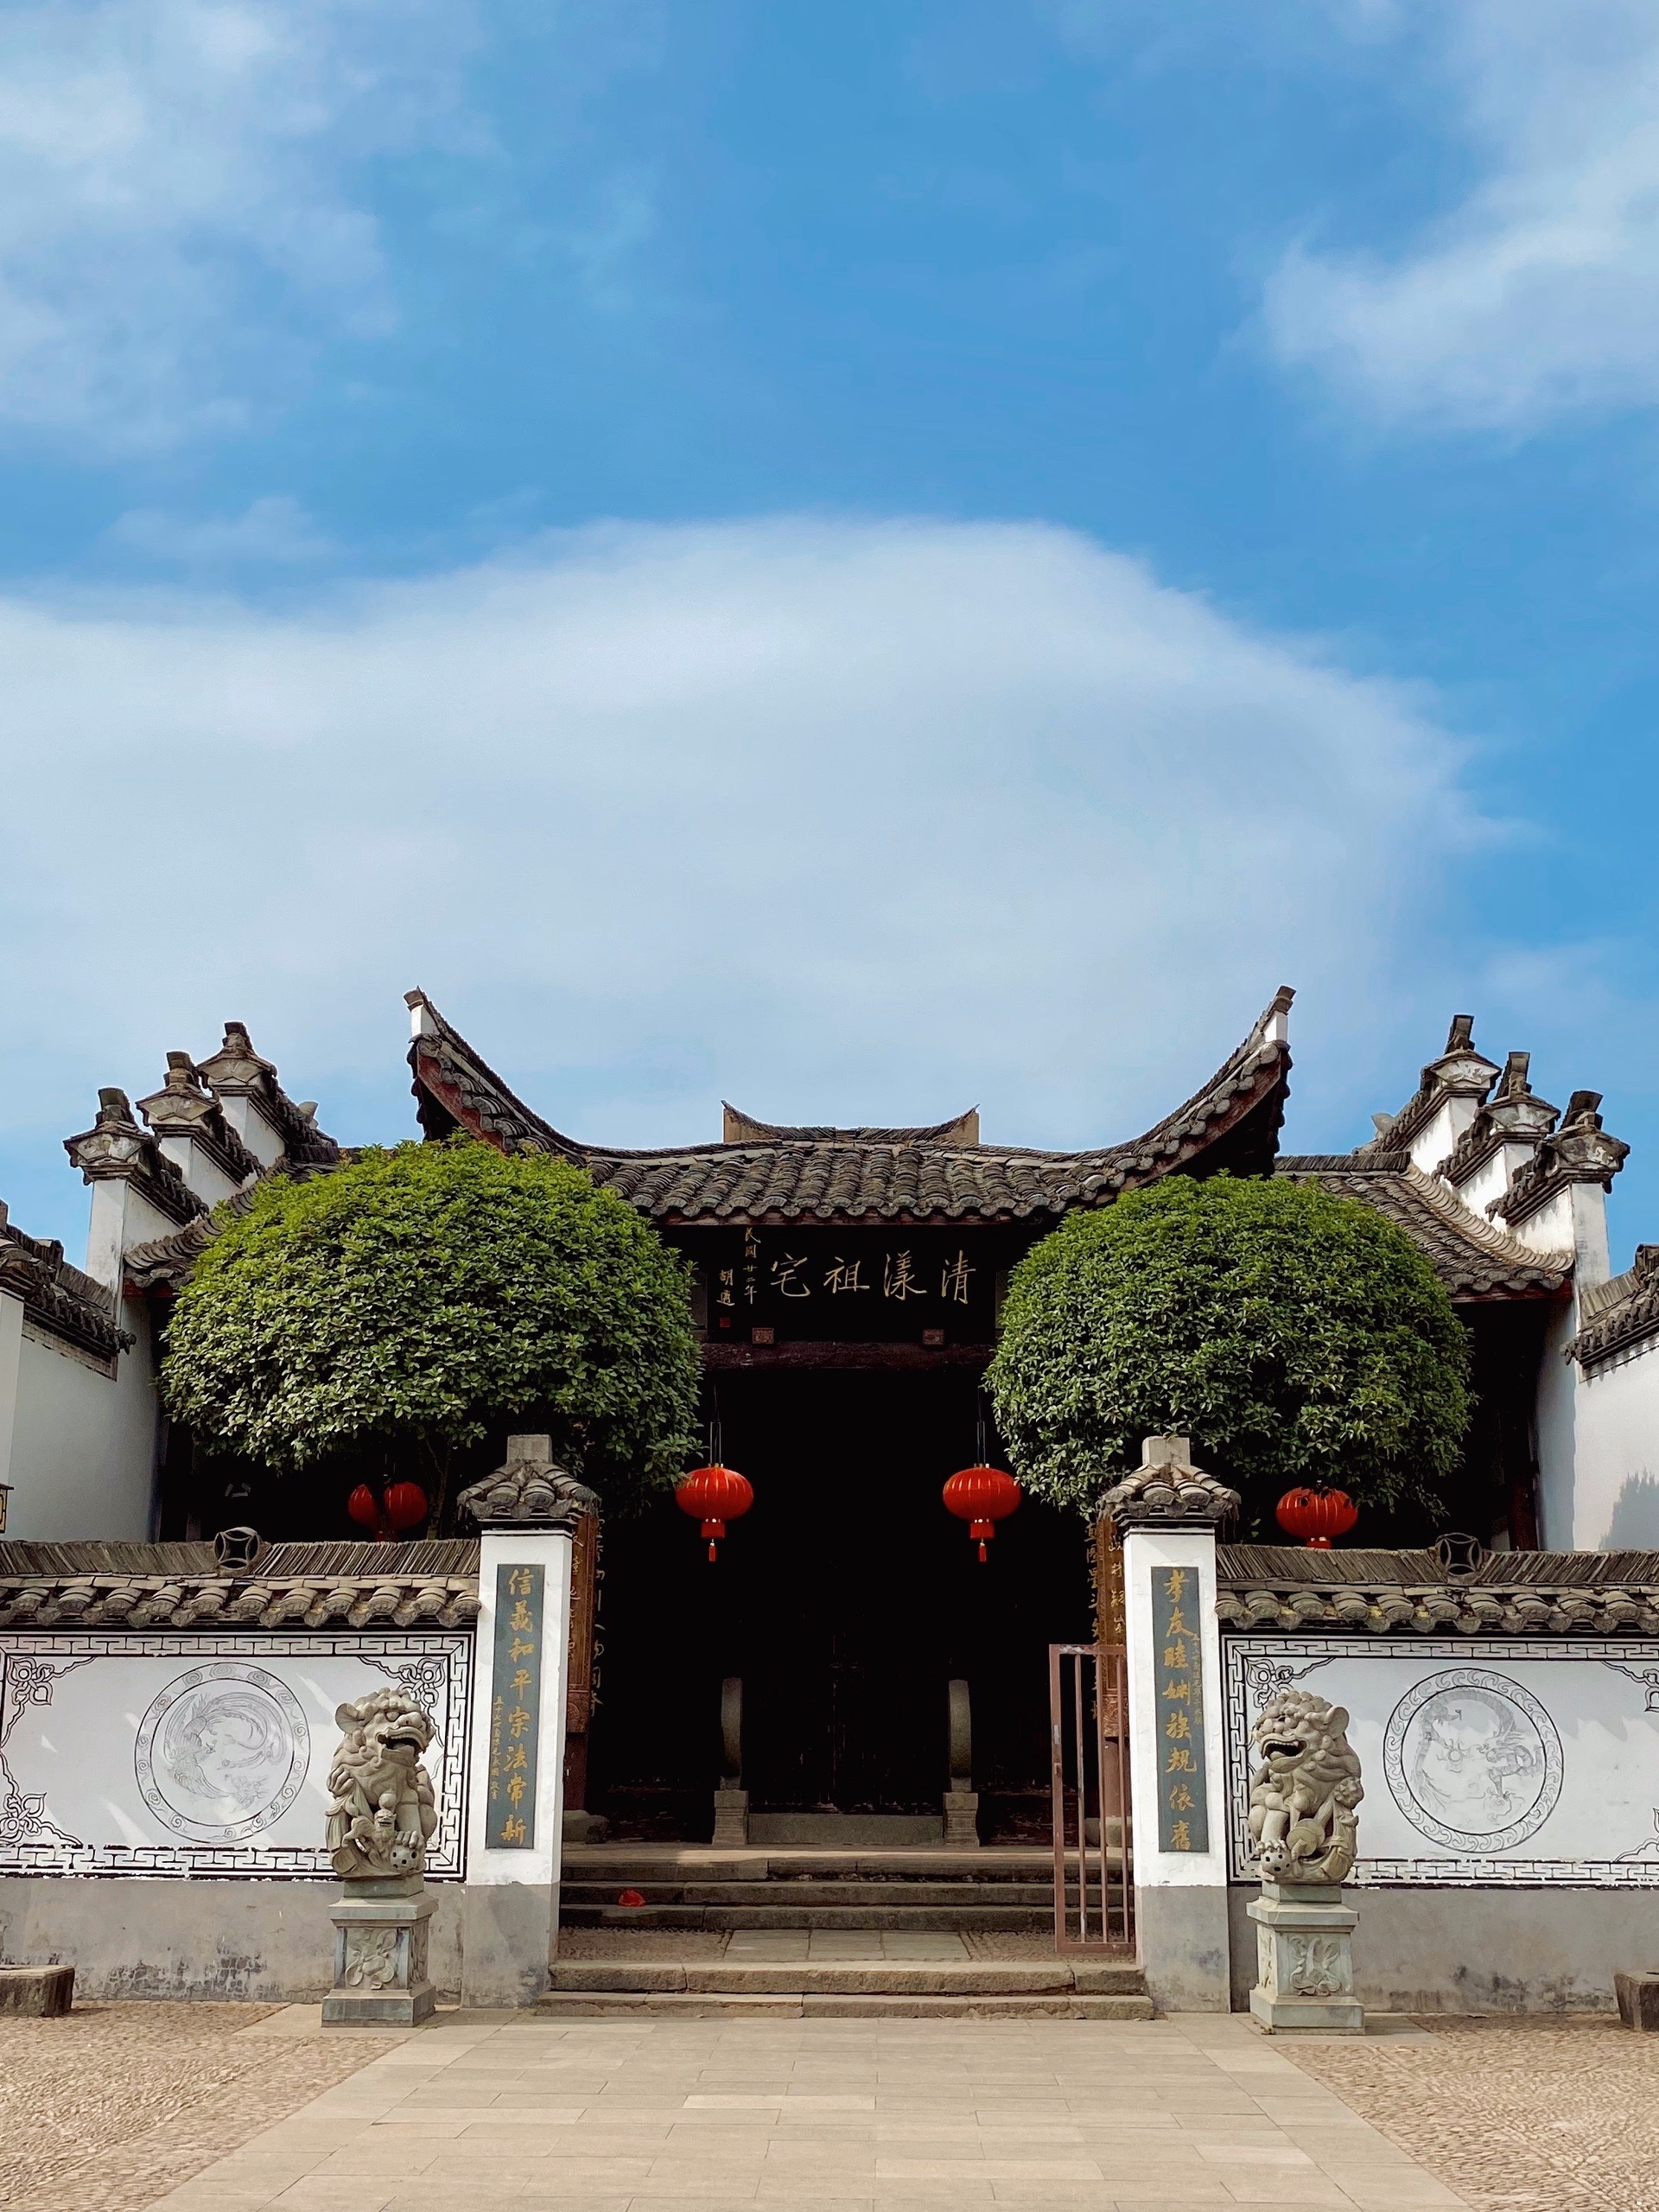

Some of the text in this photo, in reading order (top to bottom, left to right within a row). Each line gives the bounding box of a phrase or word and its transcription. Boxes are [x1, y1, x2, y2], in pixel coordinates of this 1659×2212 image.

[770, 1249, 976, 1305] 清漾祖宅
[499, 1568, 535, 1846] 信義和平宗法常新
